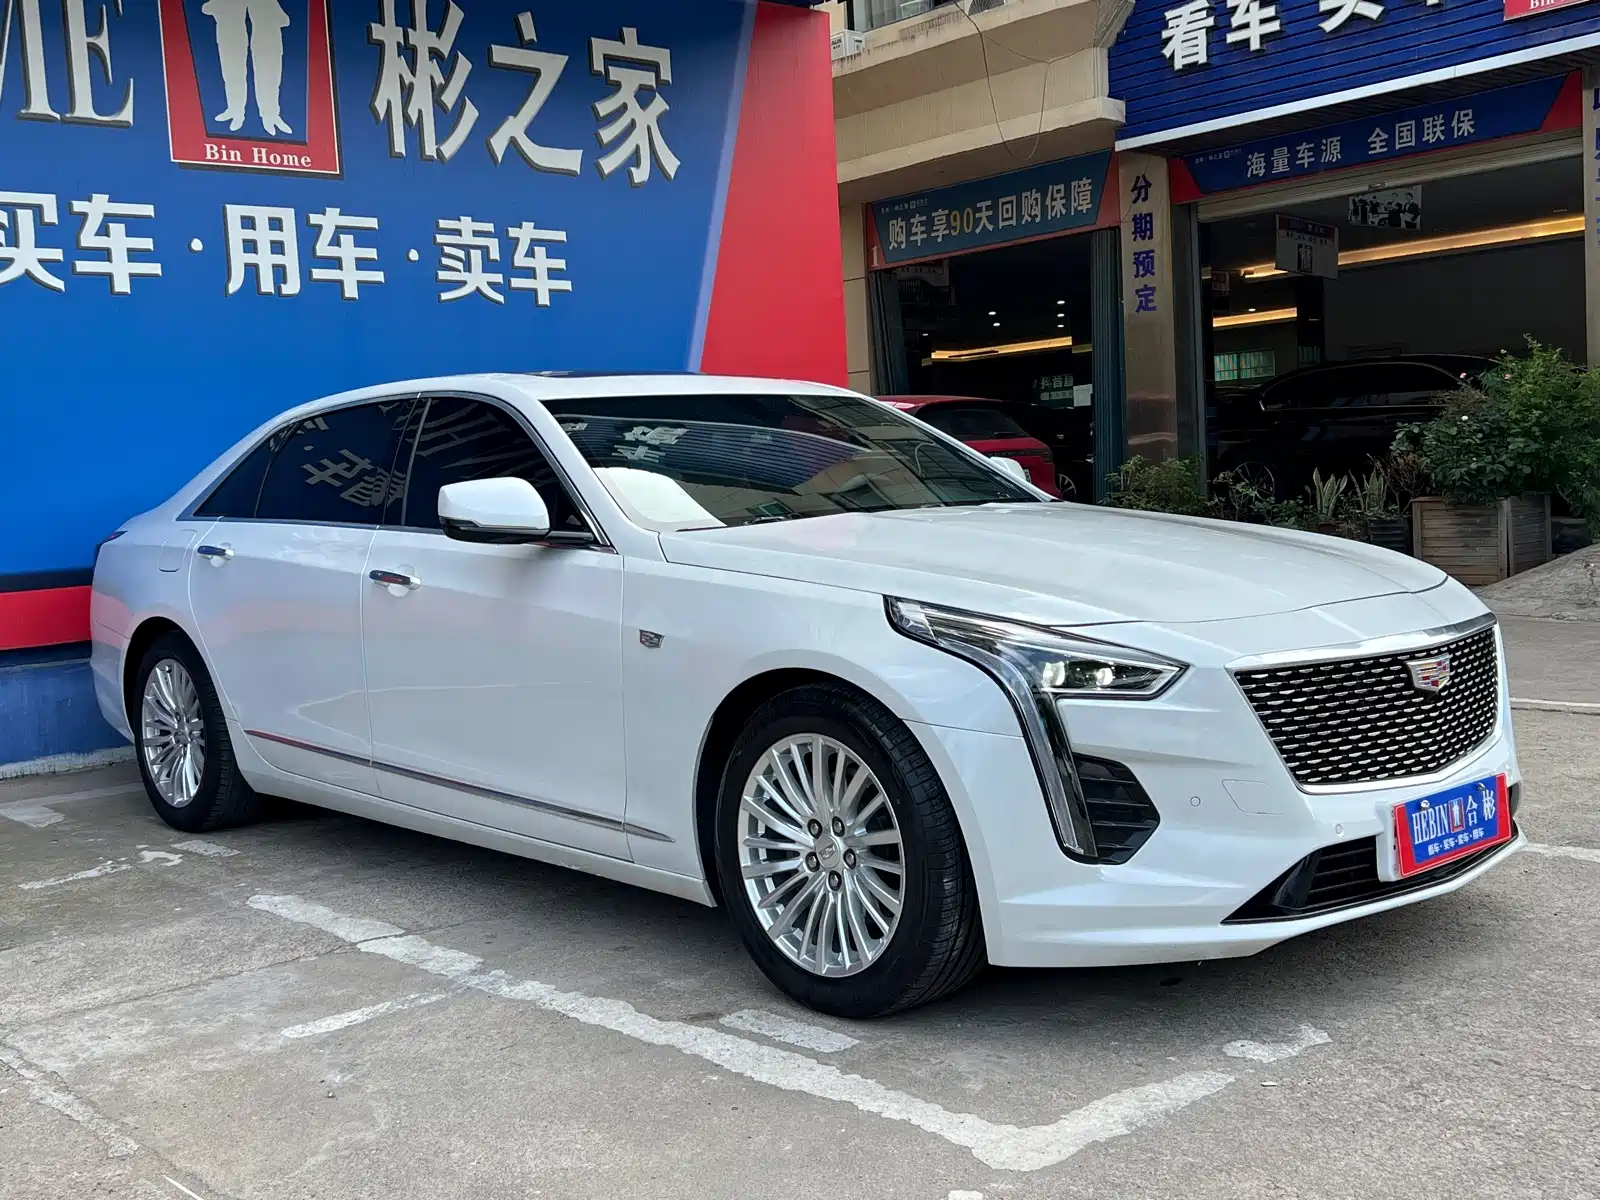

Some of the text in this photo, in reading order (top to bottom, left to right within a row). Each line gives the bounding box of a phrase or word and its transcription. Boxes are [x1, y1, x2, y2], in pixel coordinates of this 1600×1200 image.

[367, 0, 681, 187] 彬之家
[203, 143, 312, 168] Bin Home
[1246, 136, 1342, 178] 海量车源
[1367, 108, 1476, 156] 全国联保
[888, 177, 1093, 251] 购车享90天回购保障
[1131, 174, 1157, 314] 分期预定
[1411, 803, 1450, 844] HEBIN
[1466, 789, 1496, 826] 合彬
